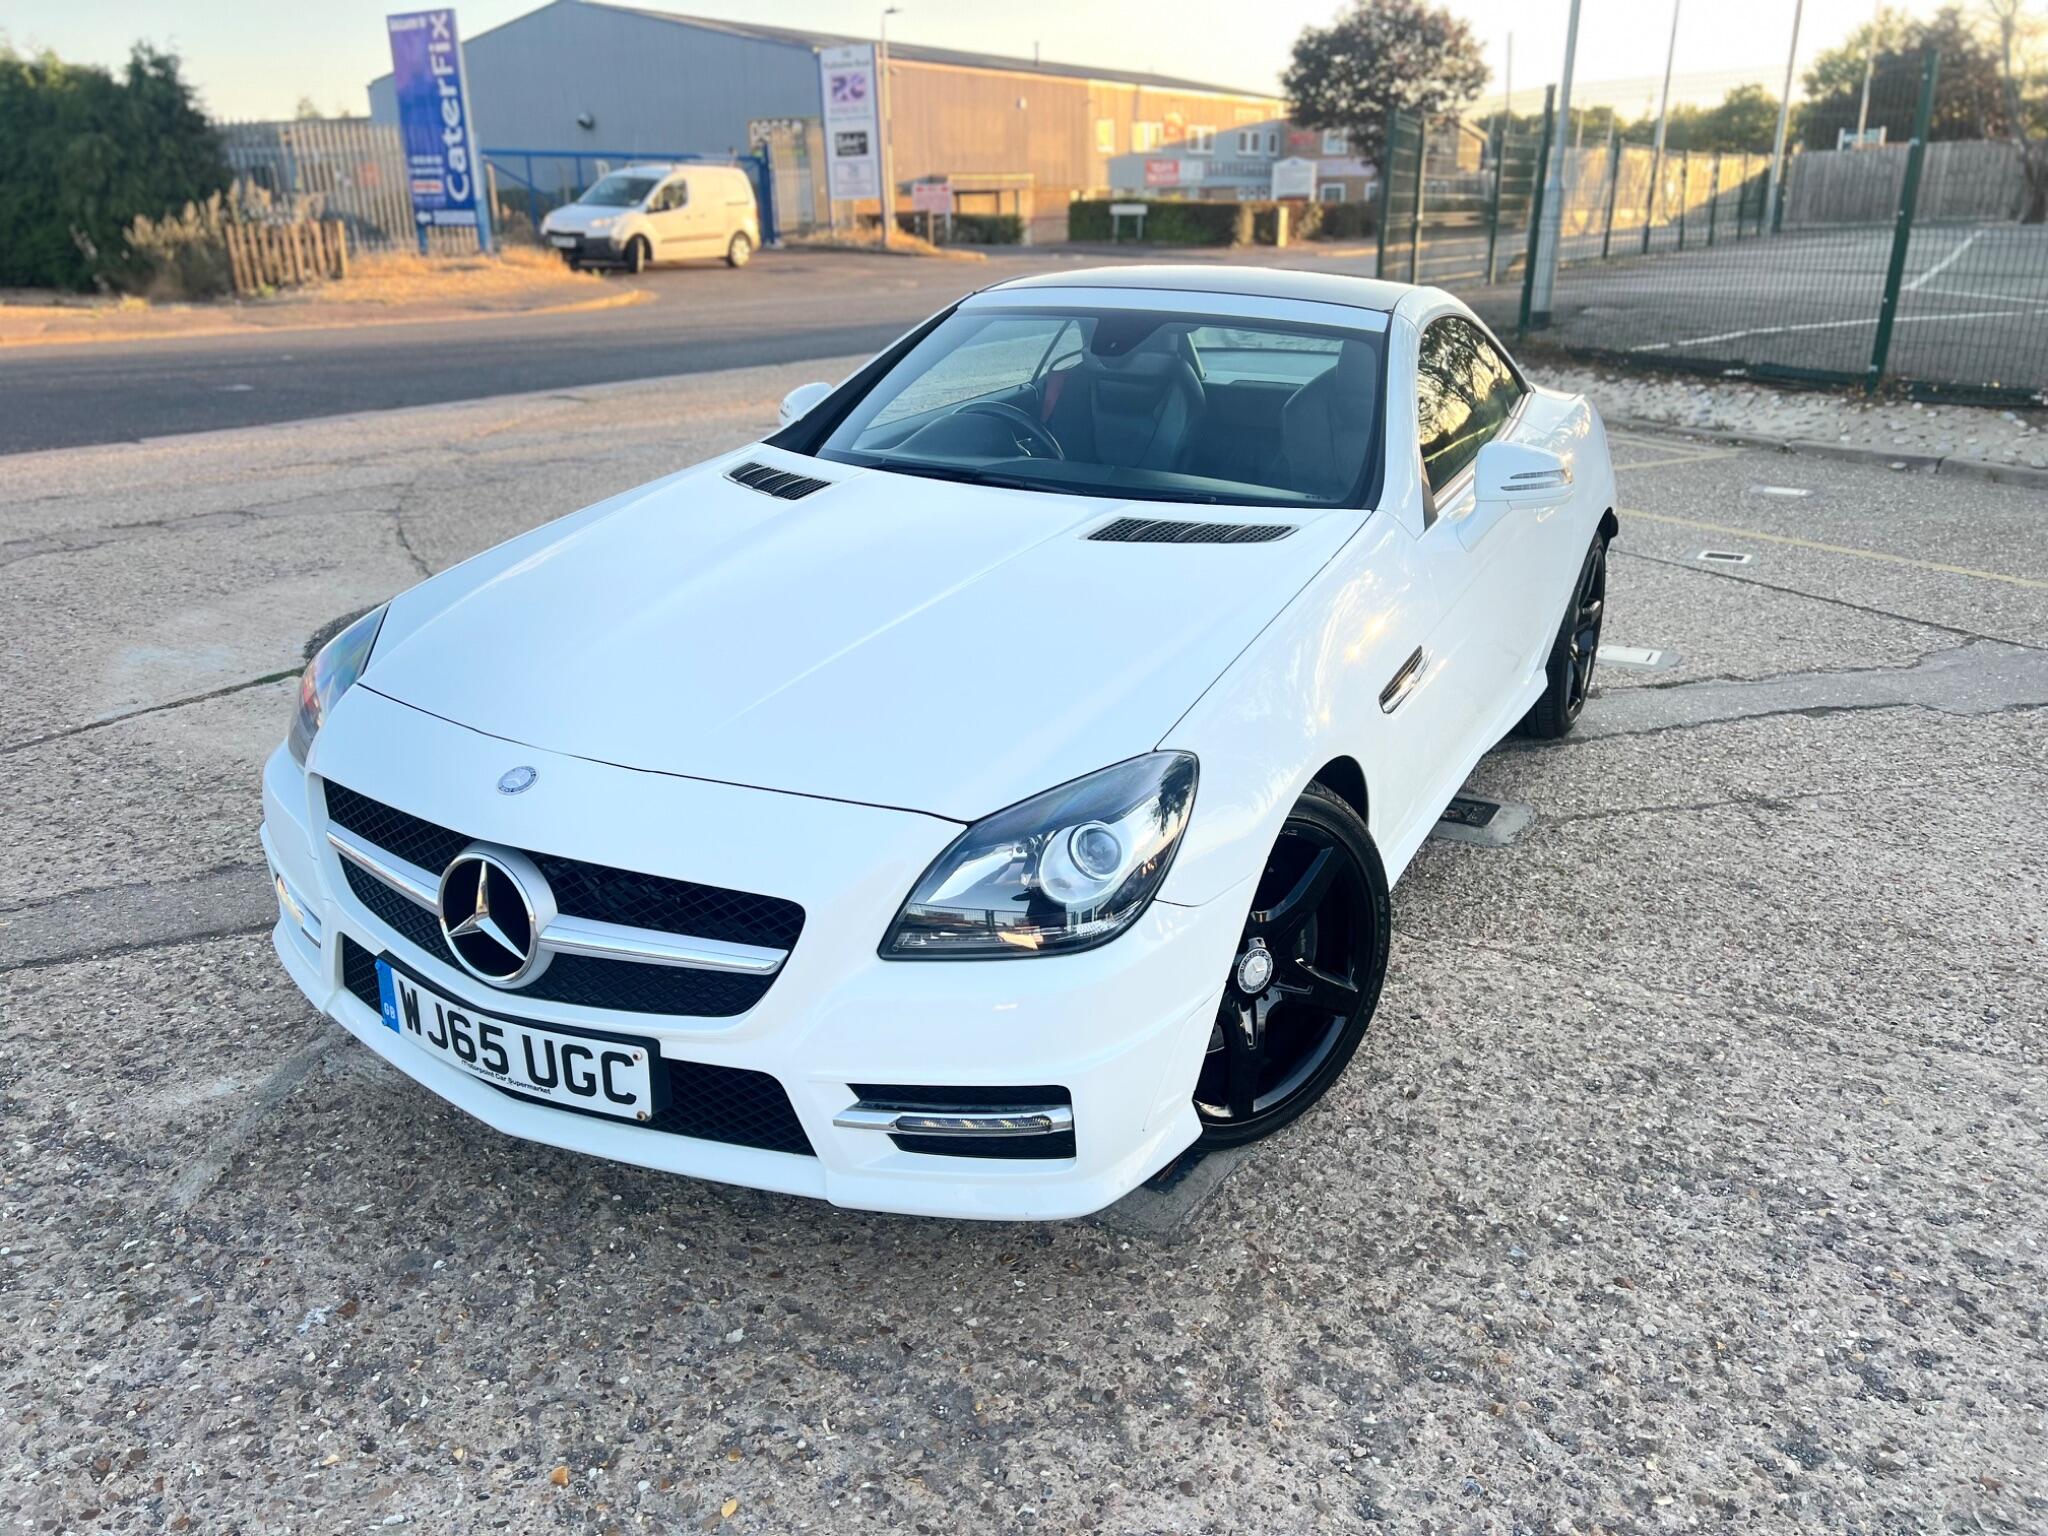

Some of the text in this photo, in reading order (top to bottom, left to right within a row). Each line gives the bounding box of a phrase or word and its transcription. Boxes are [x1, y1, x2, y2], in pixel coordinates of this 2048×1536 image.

[383, 1002, 396, 1020] GB
[398, 980, 637, 1105] WJ65 UGC
[495, 1073, 506, 1081] Car
[508, 1077, 551, 1094] Supermarket
